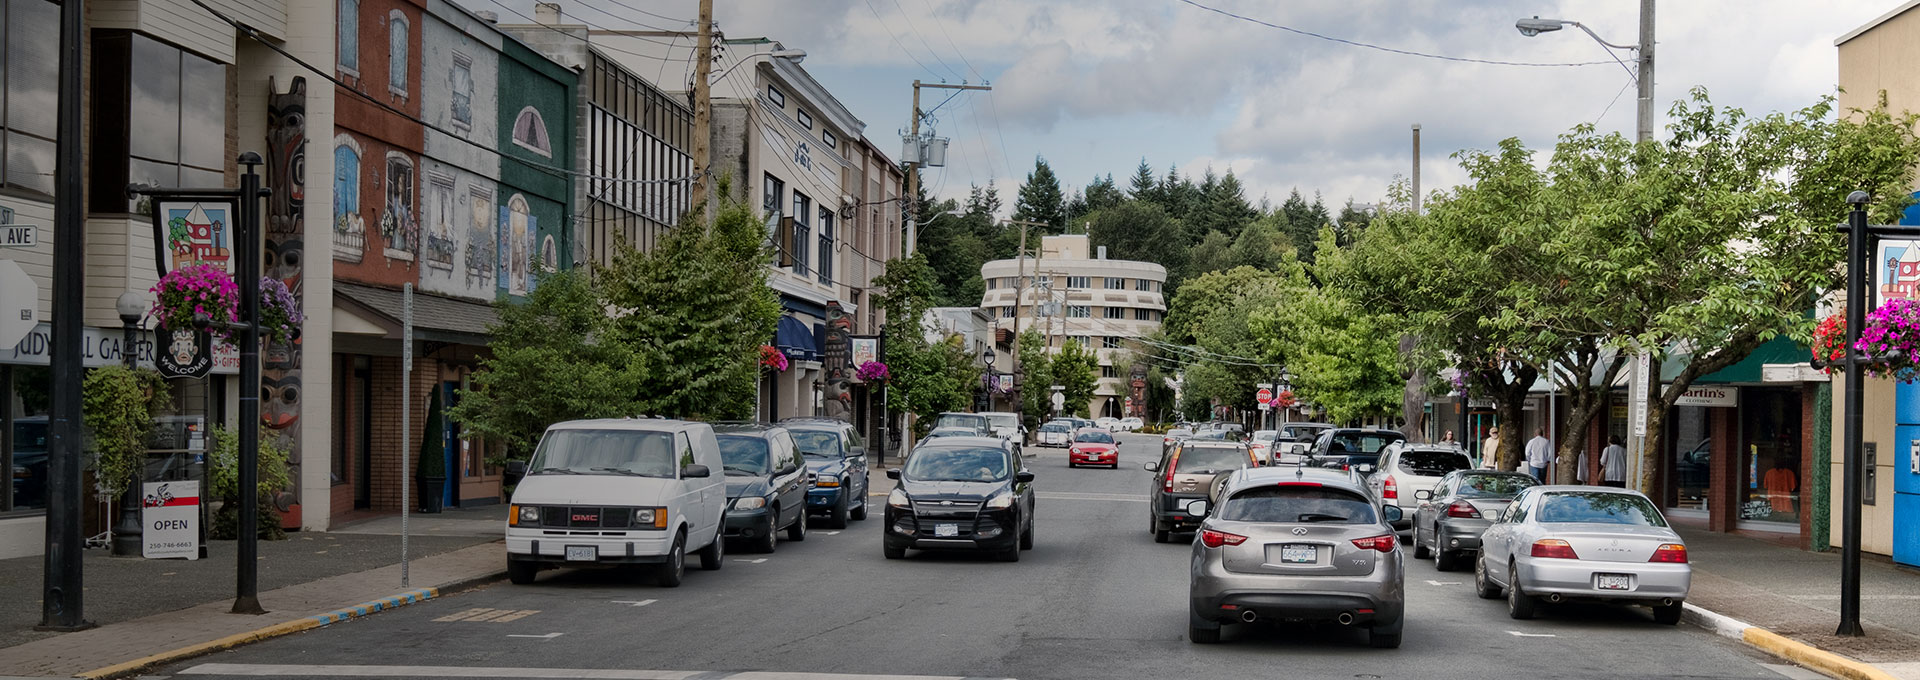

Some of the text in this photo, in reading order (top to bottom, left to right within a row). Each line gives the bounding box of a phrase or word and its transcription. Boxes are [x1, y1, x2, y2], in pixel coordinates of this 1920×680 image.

[2, 209, 10, 224] ST
[8, 228, 31, 243] AVE
[161, 355, 208, 374] WELCOME
[1681, 388, 1725, 399] artin's
[154, 520, 188, 531] OPEN
